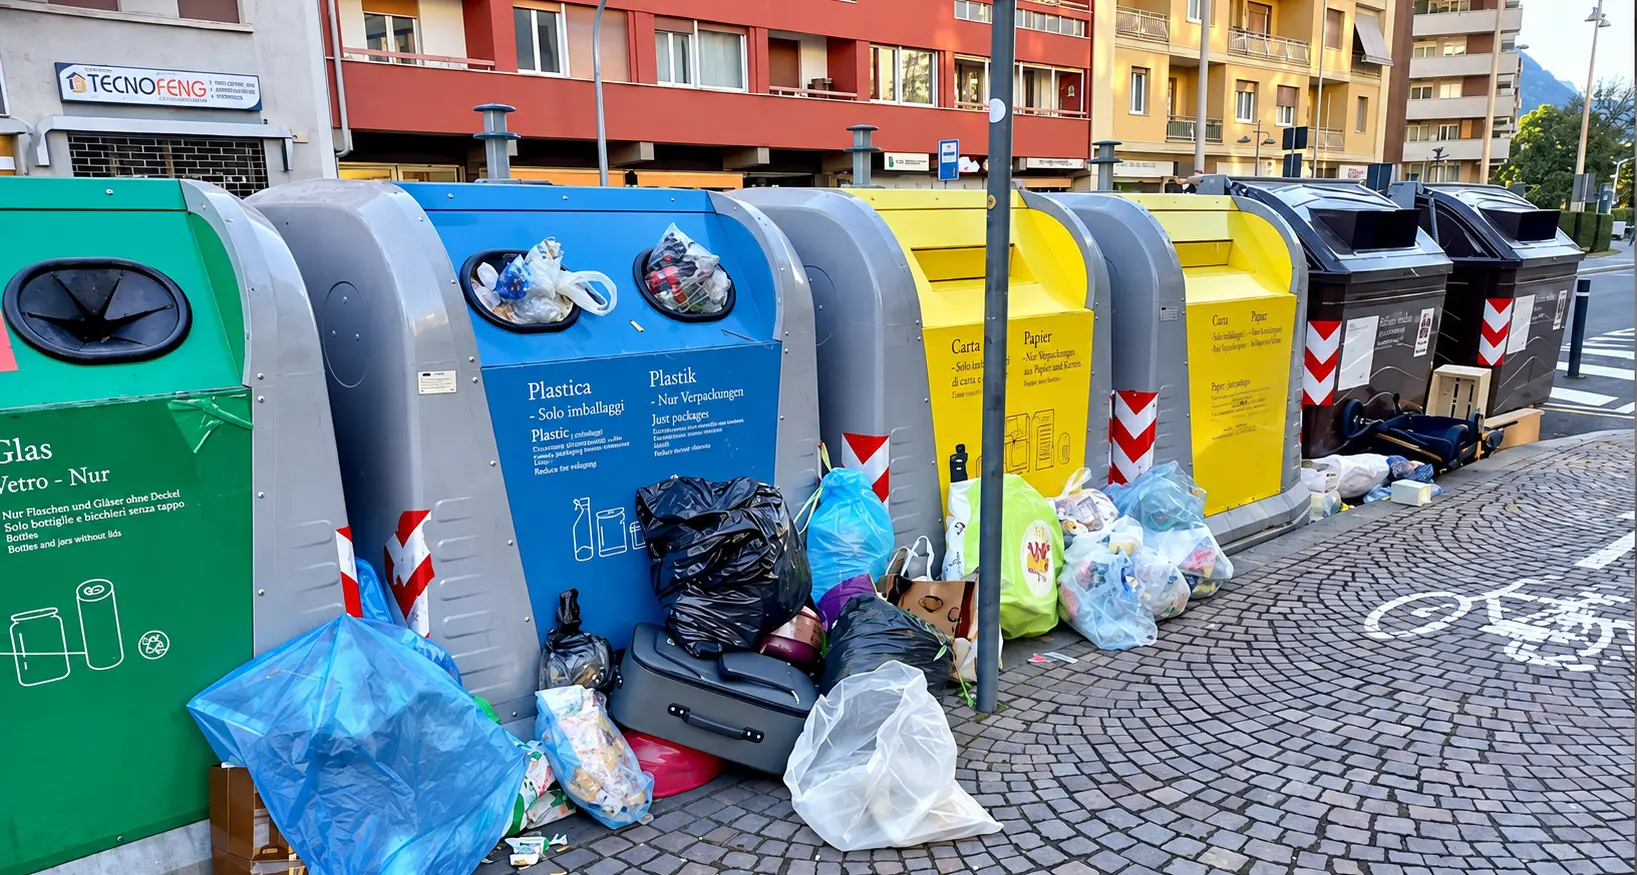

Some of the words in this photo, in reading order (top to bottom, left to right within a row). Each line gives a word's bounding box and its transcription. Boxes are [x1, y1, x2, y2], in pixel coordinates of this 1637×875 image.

[87, 73, 207, 98] TECNOFENG
[951, 338, 980, 354] Carta
[1024, 330, 1052, 348] Papier
[956, 361, 971, 372] Solo
[649, 367, 696, 387] Plastik
[528, 379, 592, 400] Plastica
[658, 394, 679, 407] Nur
[680, 387, 744, 405] Verpackungen
[538, 406, 565, 421] Solo
[568, 399, 625, 418] imballaggi
[651, 413, 670, 426] Just
[531, 427, 570, 443] Plastic
[0, 437, 52, 465] Glas
[68, 466, 110, 486] Nur
[2, 510, 24, 520] Nur
[72, 501, 91, 511] und
[126, 494, 149, 504] ohne
[150, 489, 181, 501] Deckel
[4, 520, 29, 533] Solo
[128, 506, 155, 516] senza
[157, 501, 185, 513] tappo
[40, 539, 56, 549] and
[74, 533, 107, 544] without
